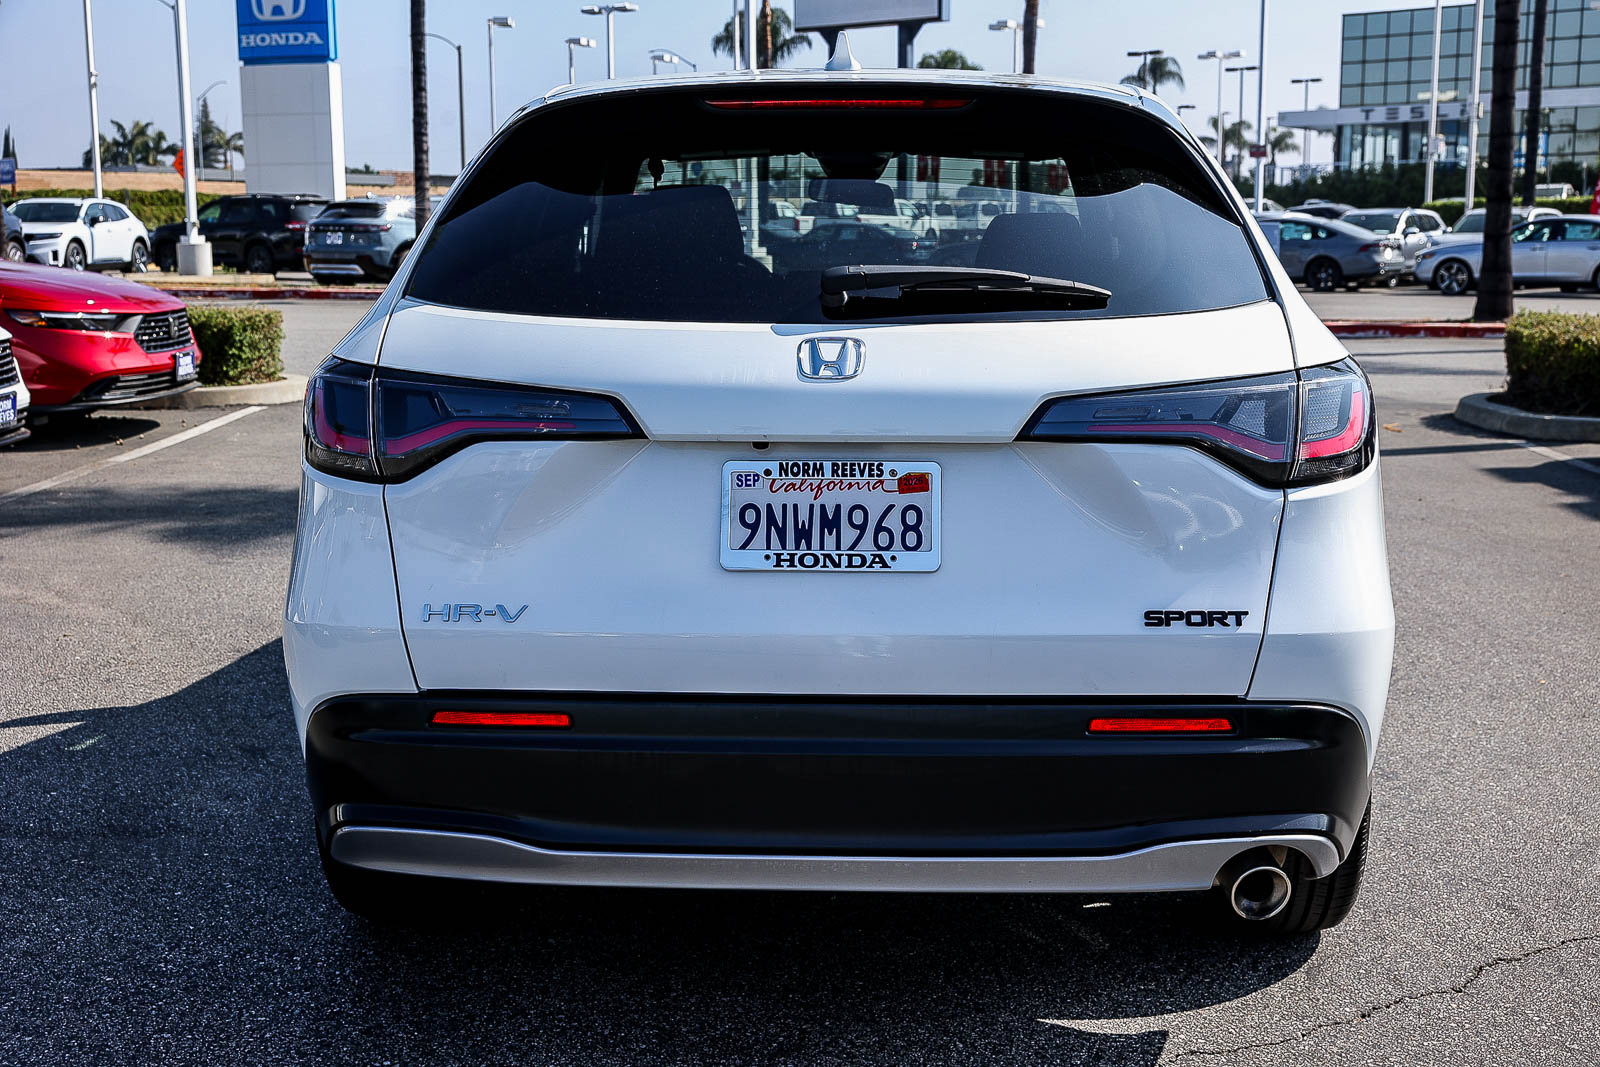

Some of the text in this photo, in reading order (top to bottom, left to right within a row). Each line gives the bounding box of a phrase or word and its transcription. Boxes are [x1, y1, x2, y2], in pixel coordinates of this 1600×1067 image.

[241, 32, 323, 48] HONDA
[778, 462, 884, 478] NORM REEVES
[736, 473, 760, 488] SEP
[769, 479, 896, 500] California
[738, 503, 923, 551] 9NWM968
[772, 552, 891, 569] HONDA
[423, 603, 528, 622] HR-V
[1144, 610, 1249, 627] SPORT
